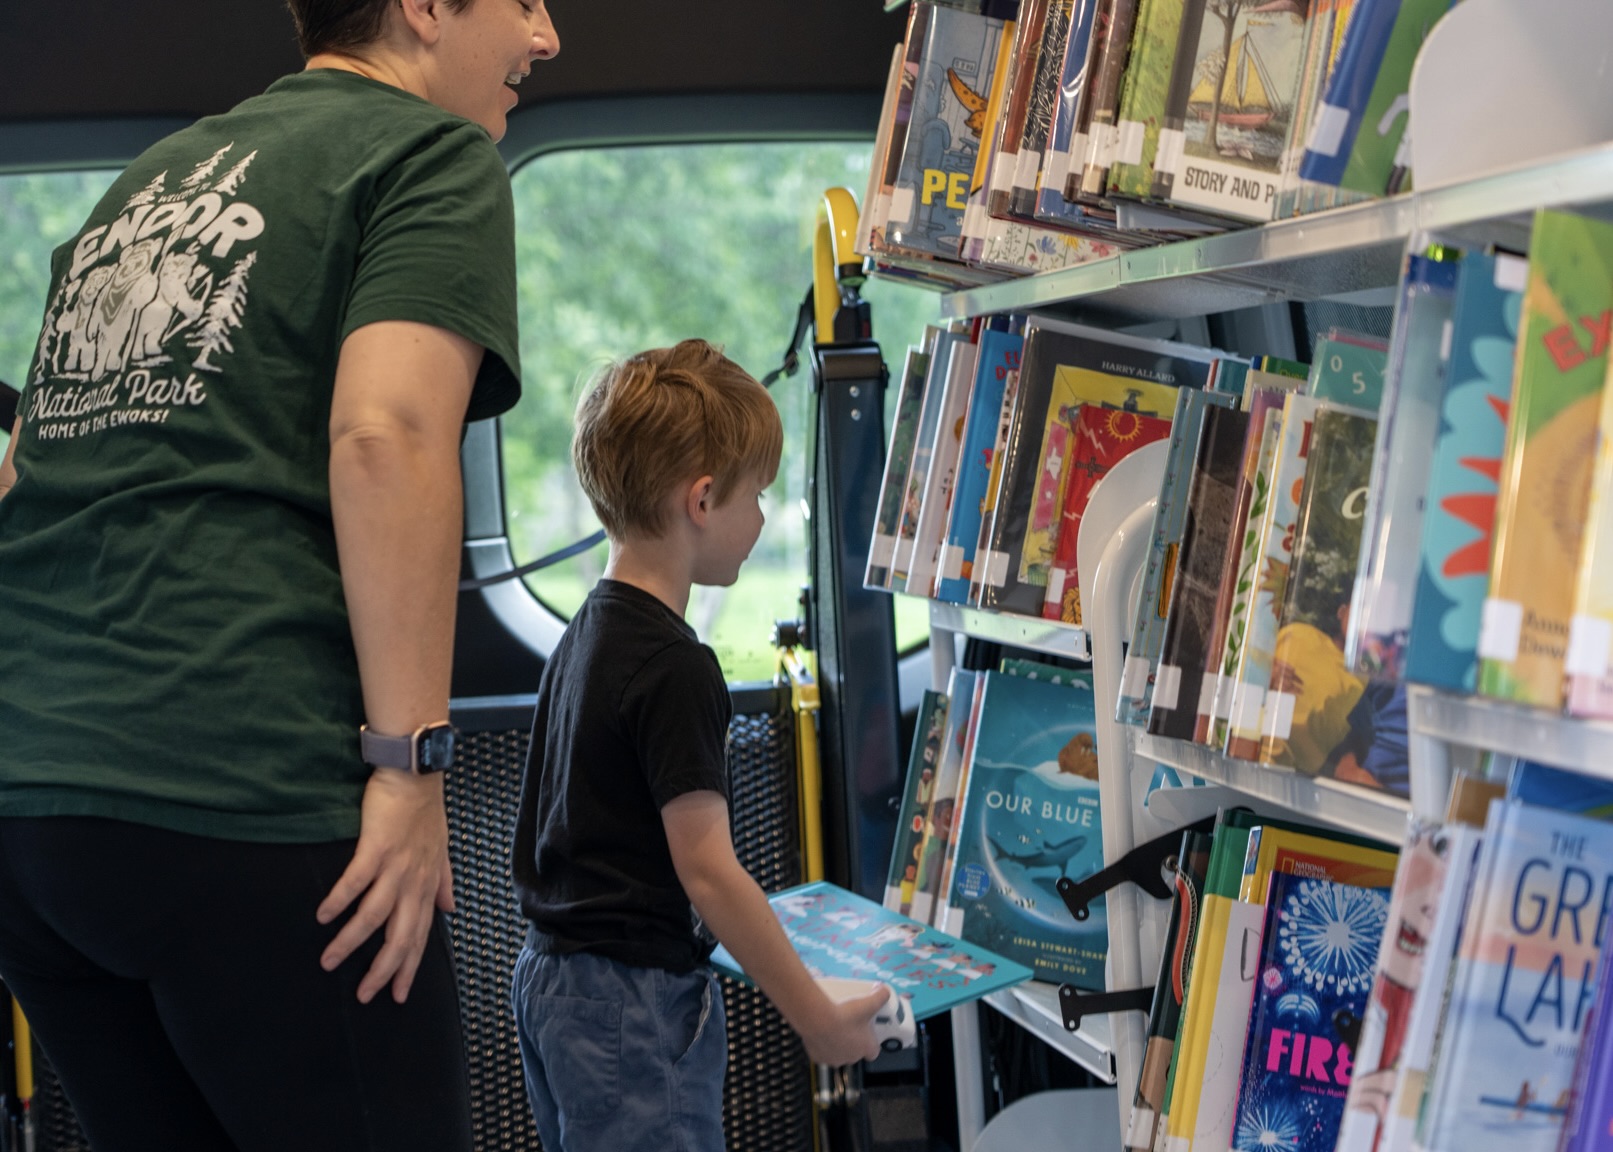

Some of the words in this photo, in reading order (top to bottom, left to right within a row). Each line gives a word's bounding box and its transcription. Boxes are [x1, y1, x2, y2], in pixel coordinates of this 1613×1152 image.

[1184, 165, 1228, 194] STORY
[1230, 175, 1261, 202] AND
[69, 192, 265, 281] ENDOR
[1102, 360, 1136, 376] HARRY
[1136, 367, 1176, 383] ALLARD
[27, 373, 121, 423] National
[124, 368, 207, 406] Park
[38, 420, 77, 441] HOME
[78, 418, 90, 436] OF
[92, 411, 108, 433] THE
[110, 407, 170, 428] EWOKS!
[986, 790, 1033, 816] OUR
[1041, 800, 1094, 828] BLUE
[1551, 830, 1588, 861] THE
[1294, 860, 1327, 874] NATIONAL
[1034, 957, 1060, 971] EMILY
[1062, 963, 1088, 976] DOVE
